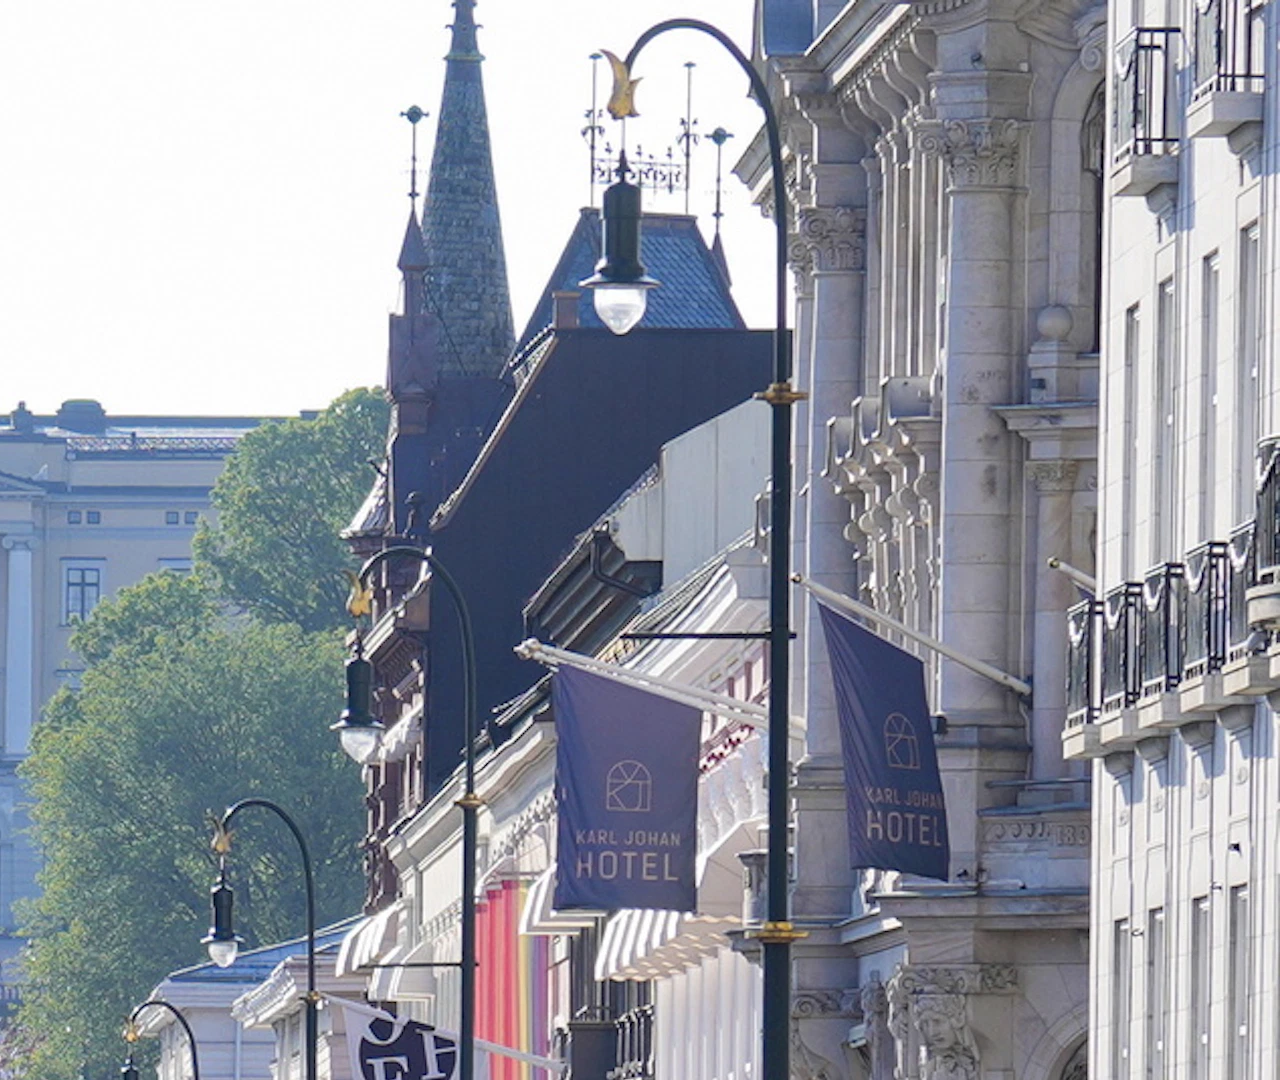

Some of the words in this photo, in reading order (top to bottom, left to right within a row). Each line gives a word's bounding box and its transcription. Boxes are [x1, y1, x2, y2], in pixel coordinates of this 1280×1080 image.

[864, 785, 902, 804] KARL
[575, 829, 619, 845] KARL
[624, 830, 680, 846] JOHAN
[866, 809, 943, 847] HOTEL
[576, 850, 679, 881] HOTEL
